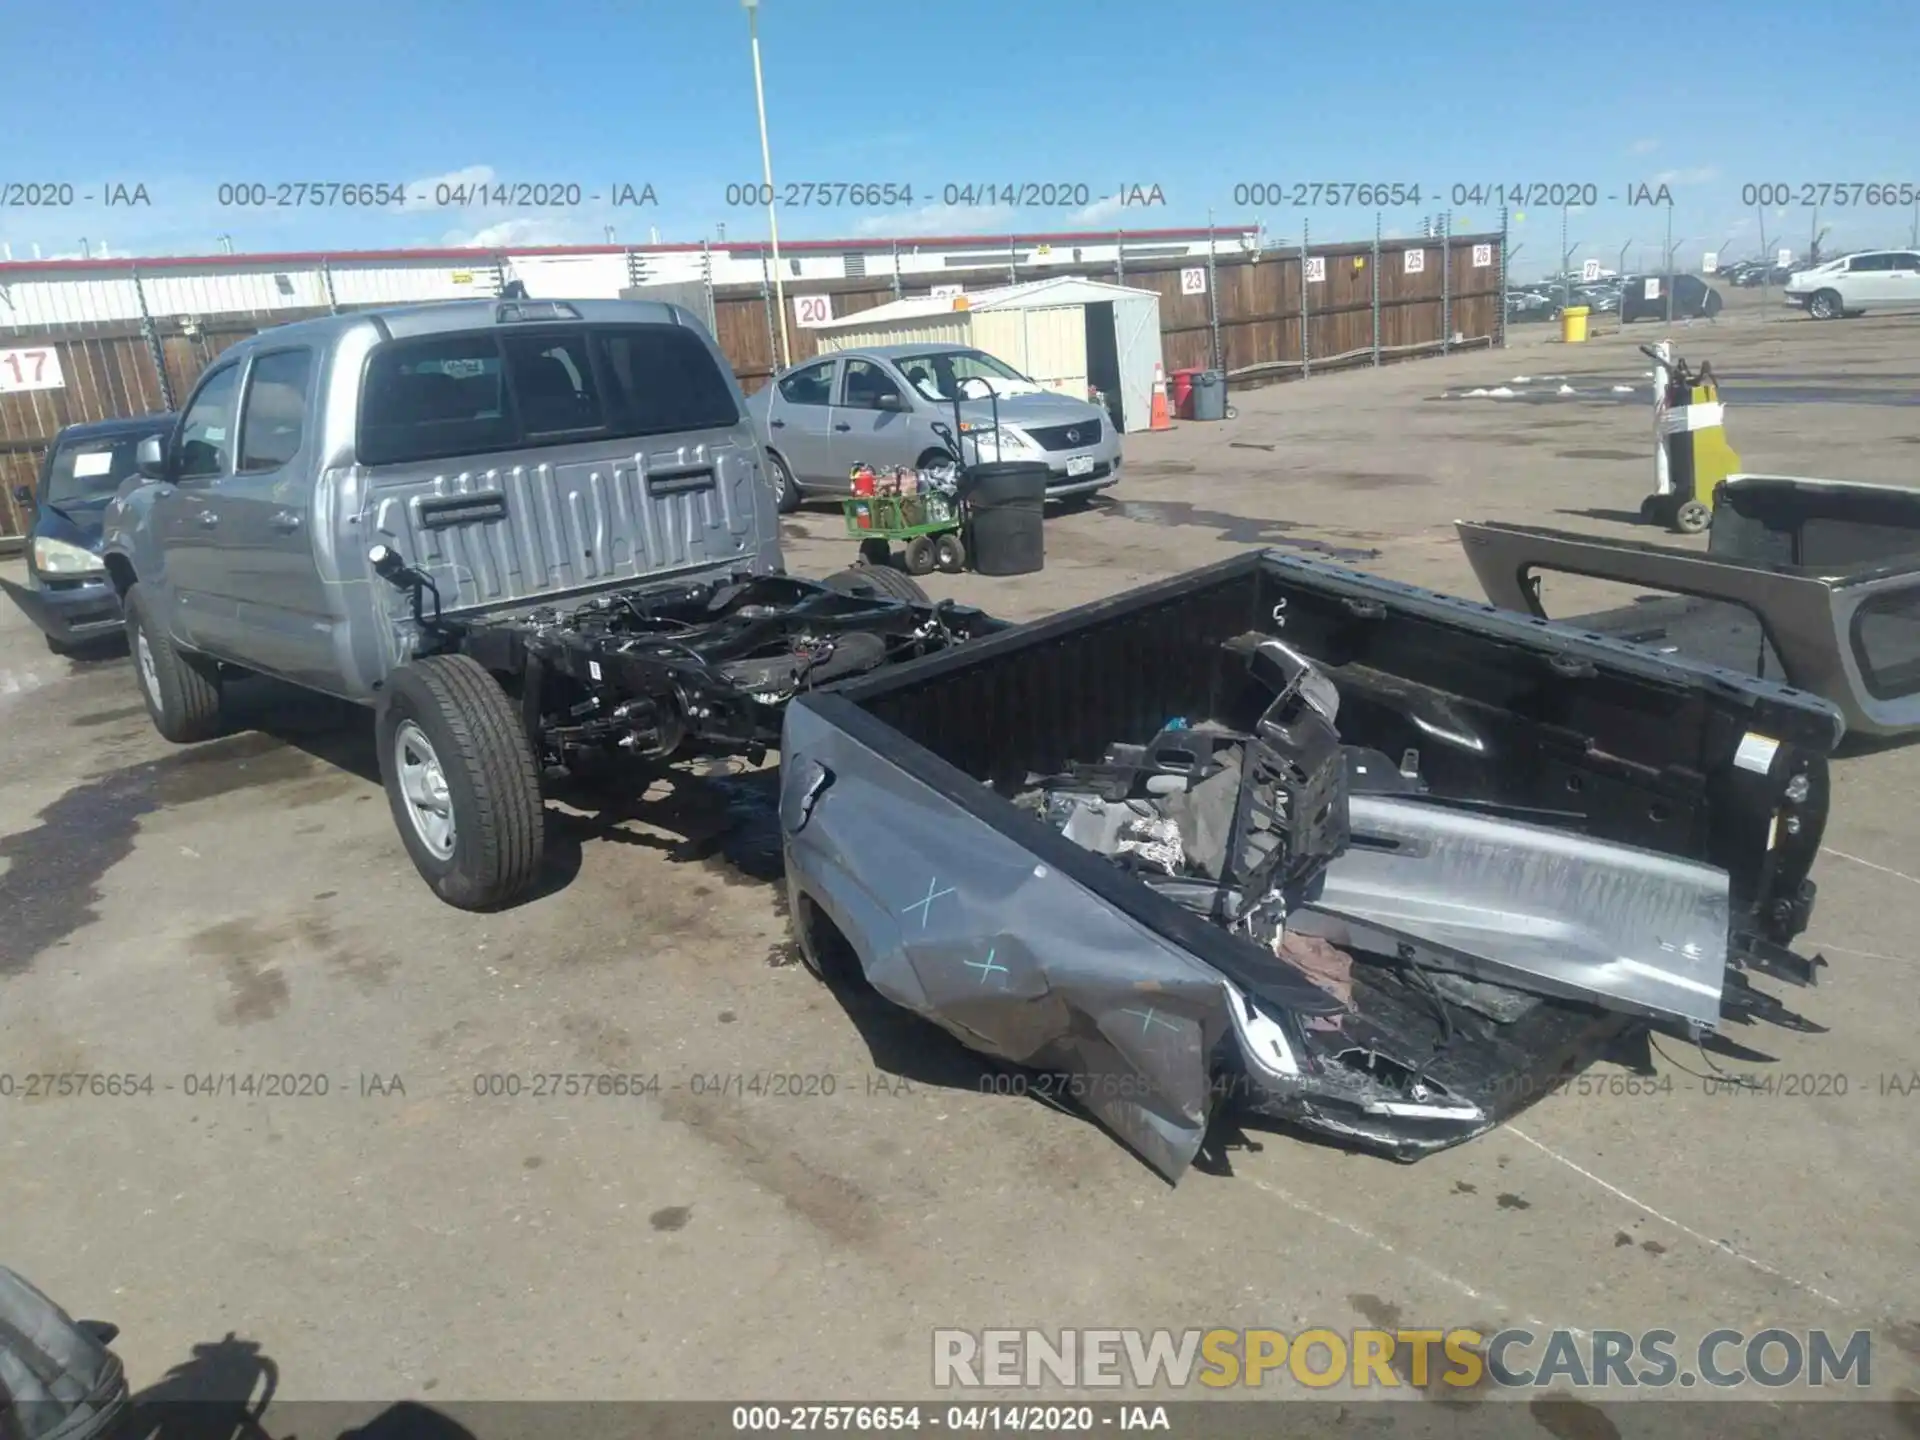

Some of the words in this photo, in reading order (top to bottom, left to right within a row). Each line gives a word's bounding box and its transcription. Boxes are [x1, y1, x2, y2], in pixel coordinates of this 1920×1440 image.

[1305, 259, 1322, 278] 24
[1186, 270, 1202, 290] 23
[800, 298, 827, 322] 20
[4, 351, 47, 383] 17
